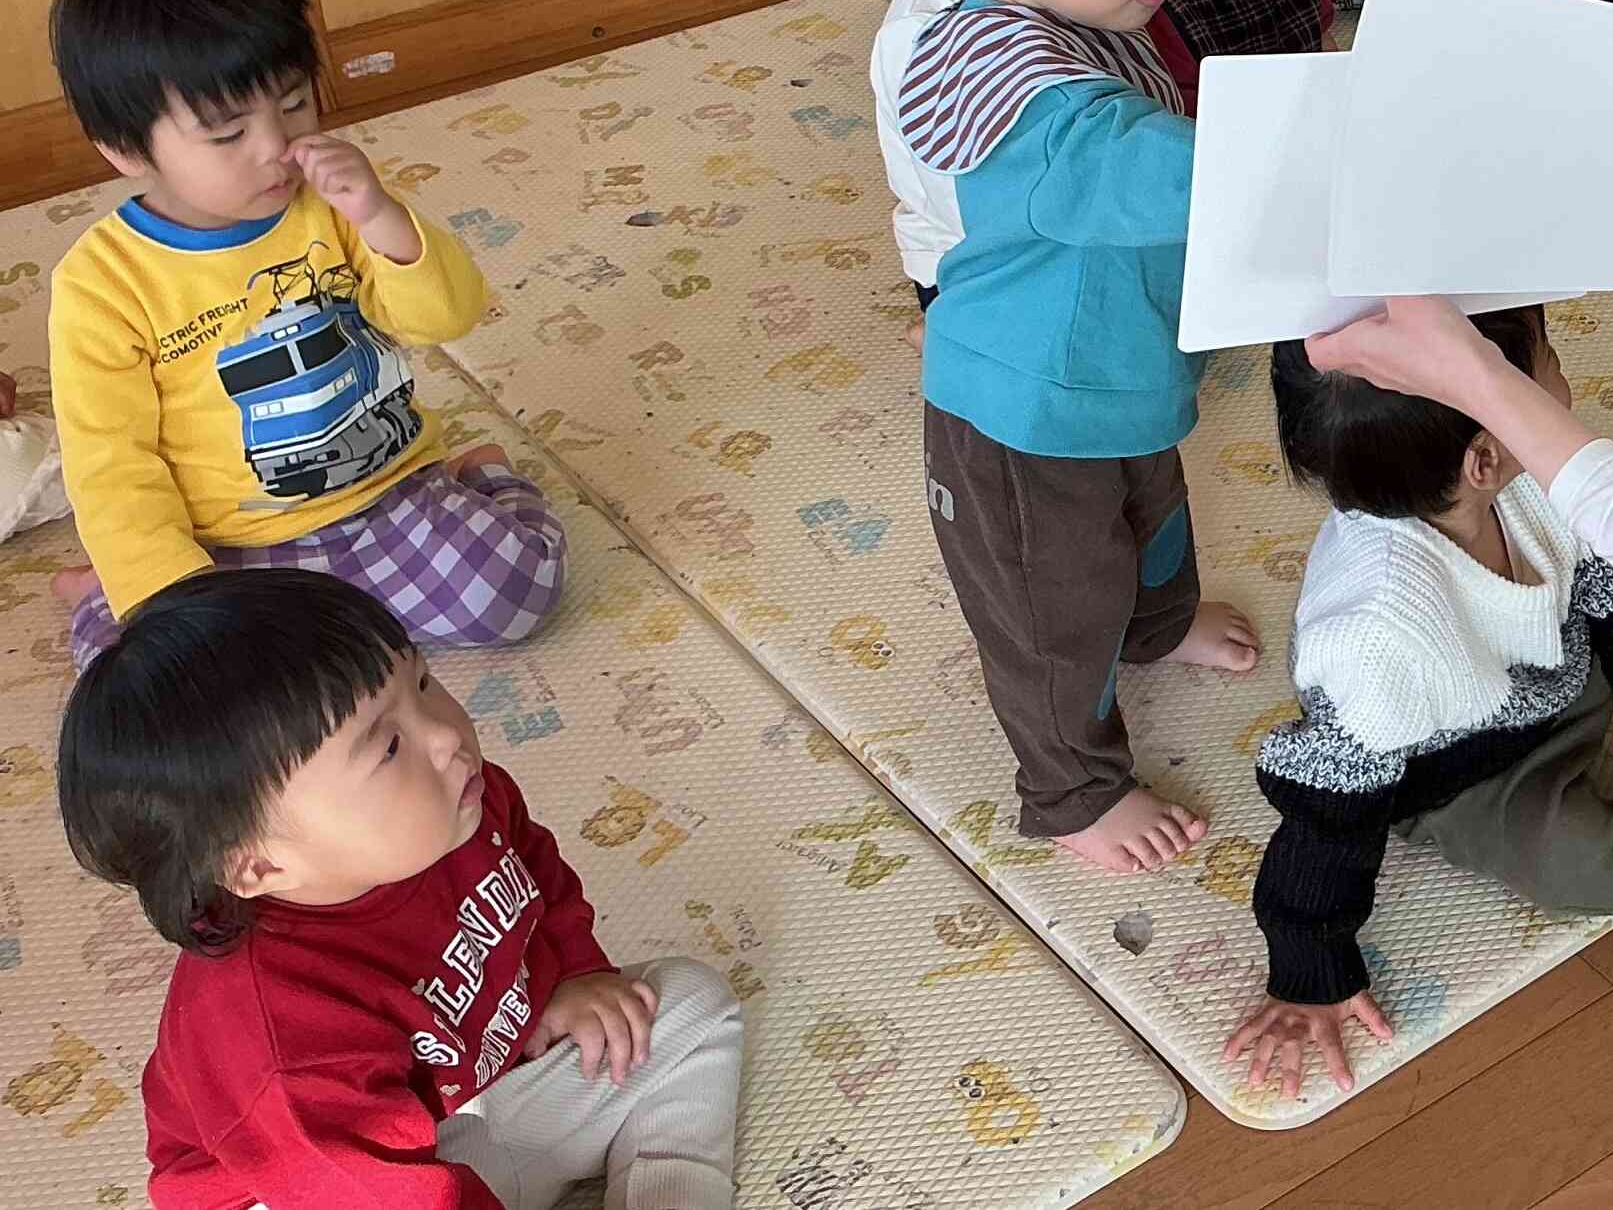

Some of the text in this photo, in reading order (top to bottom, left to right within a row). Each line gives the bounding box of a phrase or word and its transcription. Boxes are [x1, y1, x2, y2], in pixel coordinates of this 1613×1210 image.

[158, 323, 223, 364] COMOTIVE
[159, 298, 249, 349] CTRIC FREIGHT
